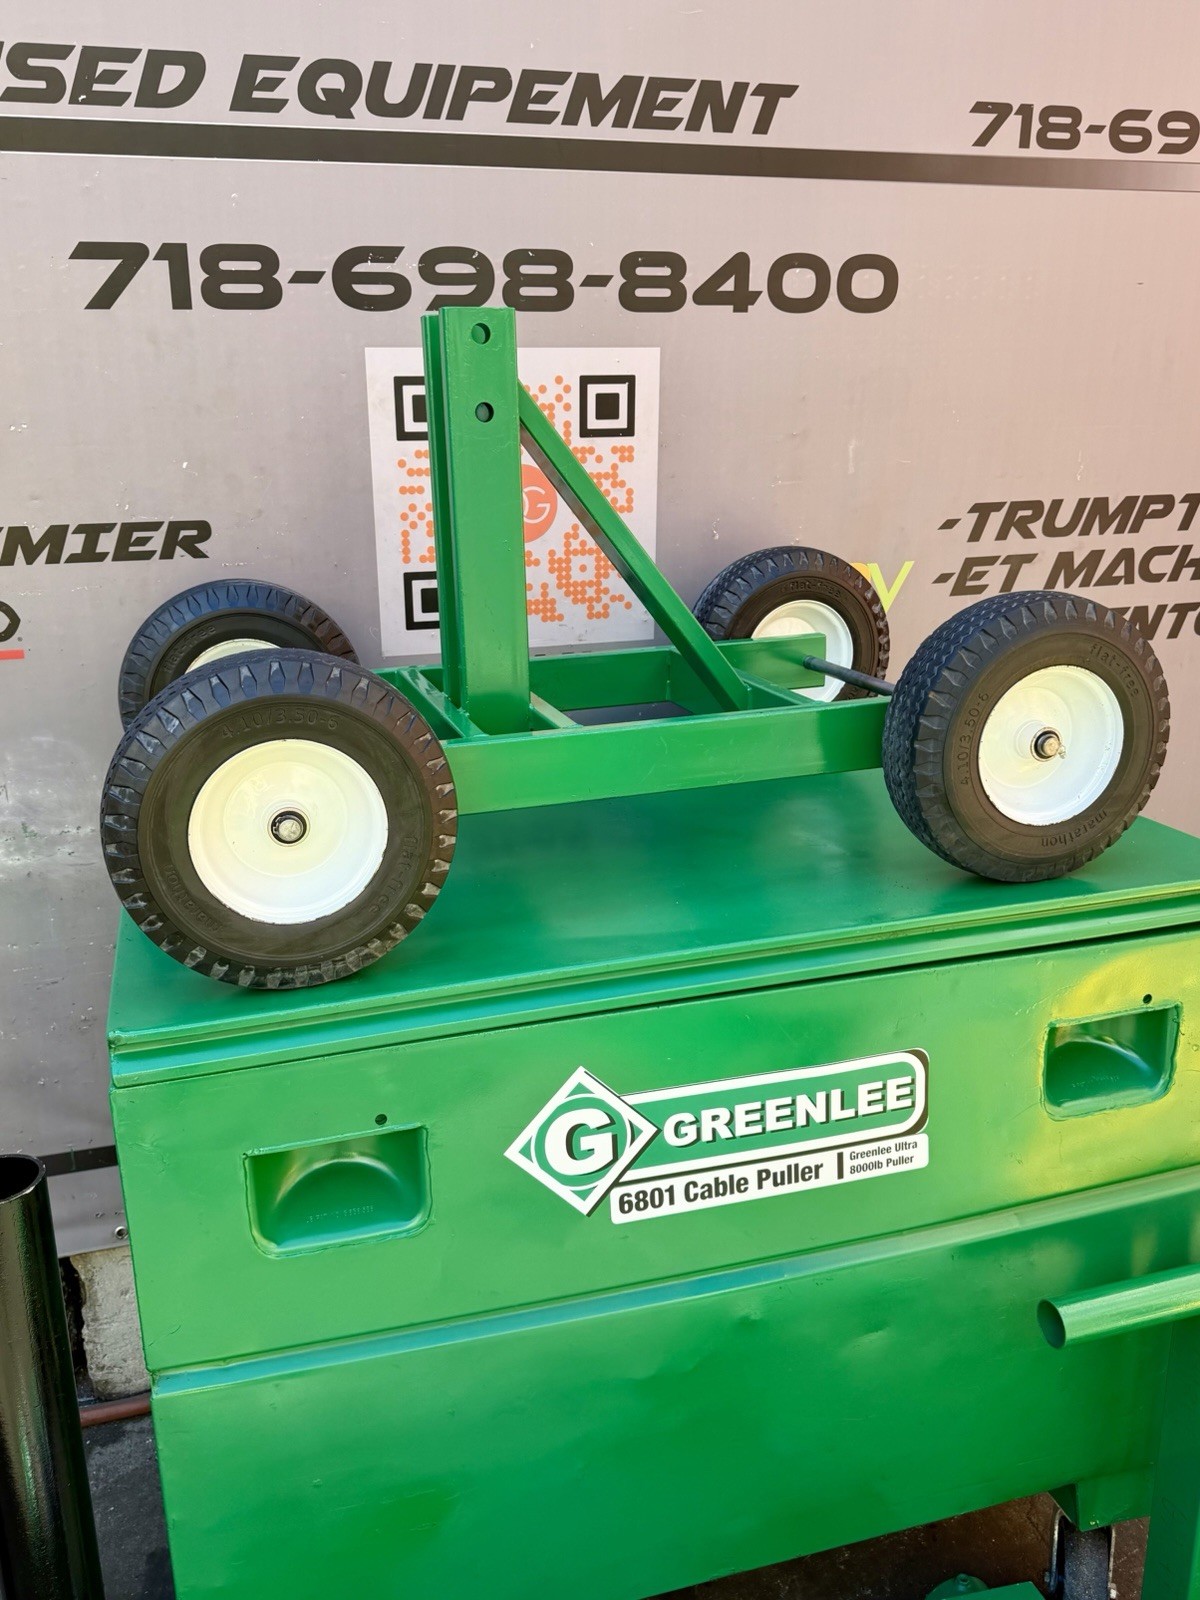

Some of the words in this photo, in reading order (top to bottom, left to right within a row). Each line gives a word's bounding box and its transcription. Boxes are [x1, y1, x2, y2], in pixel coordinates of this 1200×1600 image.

[0, 41, 206, 109] SED
[229, 53, 799, 135] EQUIPEMENT
[68, 241, 899, 313] 718-698-8400
[0, 520, 212, 566] MIER
[932, 553, 1038, 597] -ET
[663, 1075, 914, 1148] GREENLEE
[544, 1108, 614, 1178] G
[849, 1146, 892, 1161] Greenlee
[894, 1141, 918, 1152] Ultra
[849, 1160, 883, 1175] 8000lb
[886, 1155, 914, 1168] Puller
[618, 1184, 675, 1214] 6801
[684, 1171, 749, 1204] Cable
[756, 1159, 824, 1191] Puller
